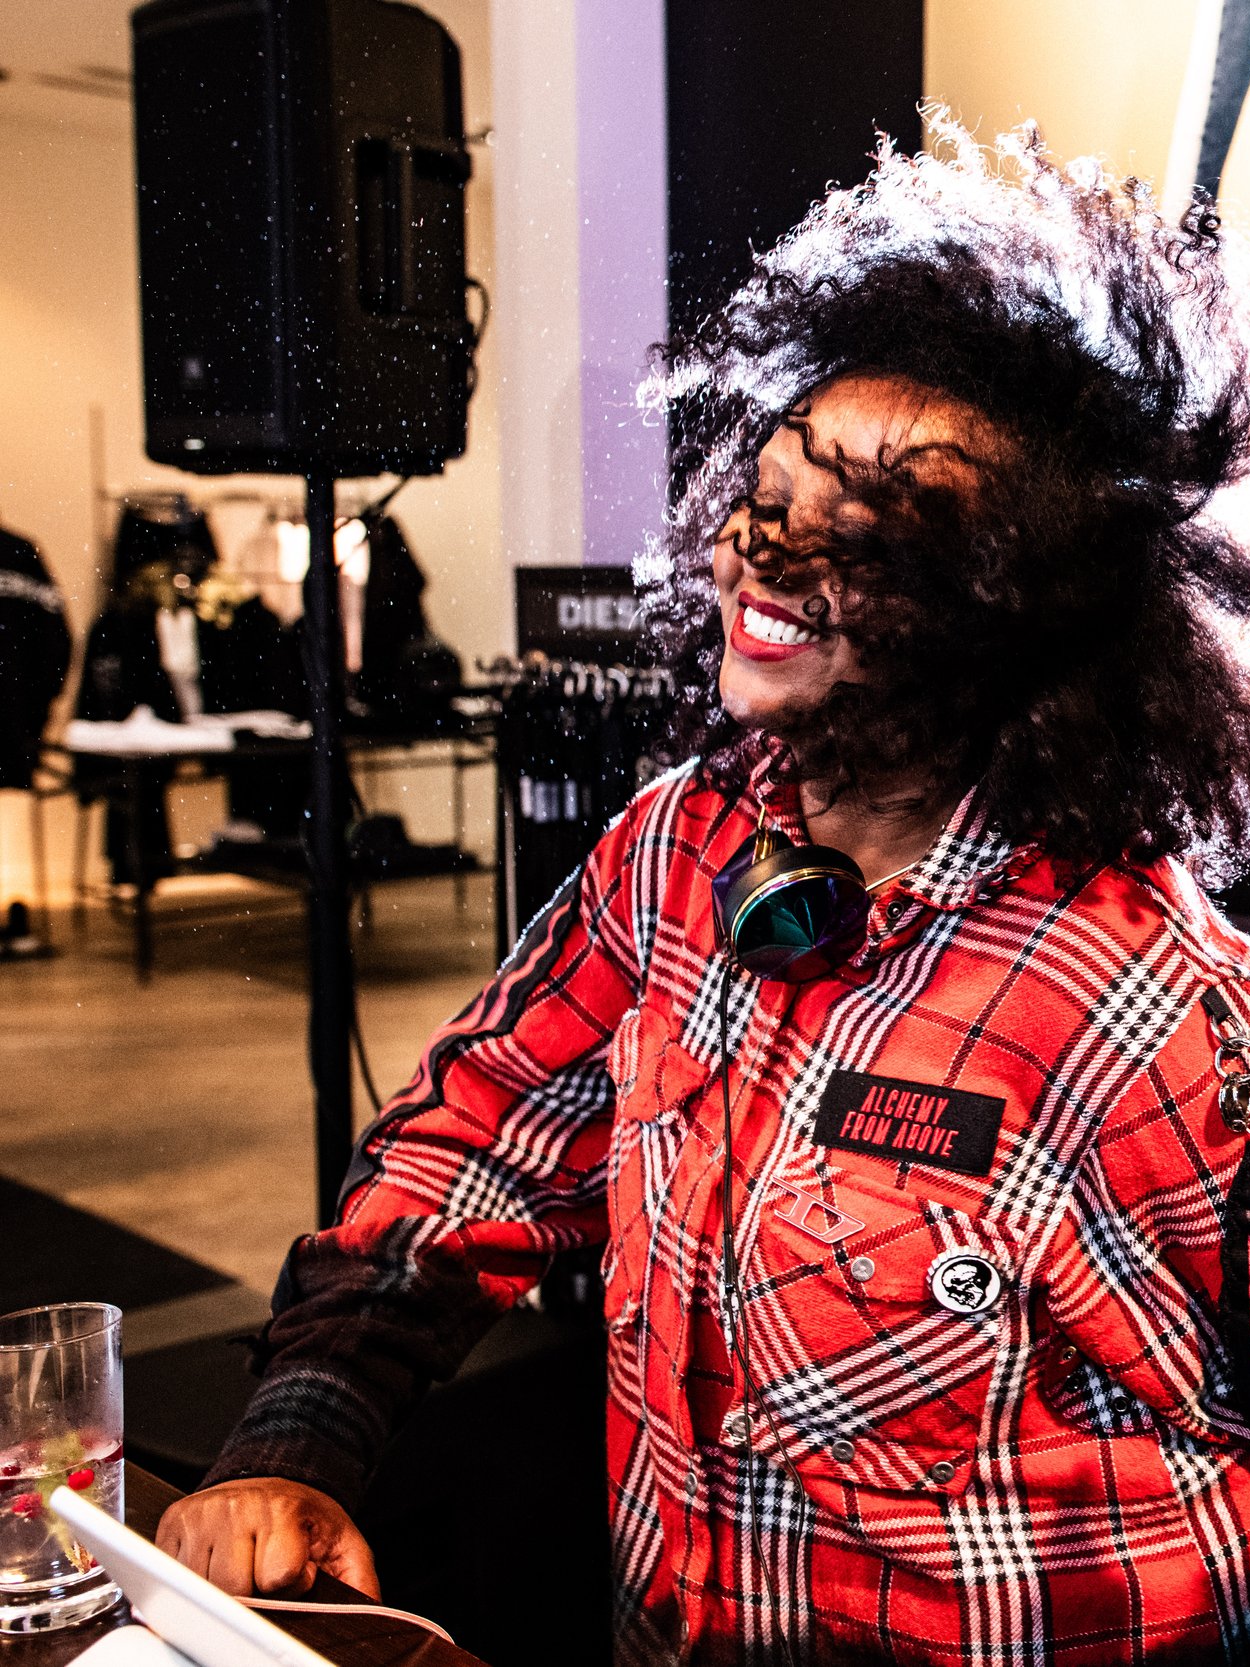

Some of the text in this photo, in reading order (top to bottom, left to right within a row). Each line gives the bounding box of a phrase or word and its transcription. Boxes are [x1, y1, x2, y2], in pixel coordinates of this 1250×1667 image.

[557, 594, 645, 631] DIES
[861, 1085, 949, 1125] ALCHEMY
[839, 1111, 960, 1157] FROM ABOVE
